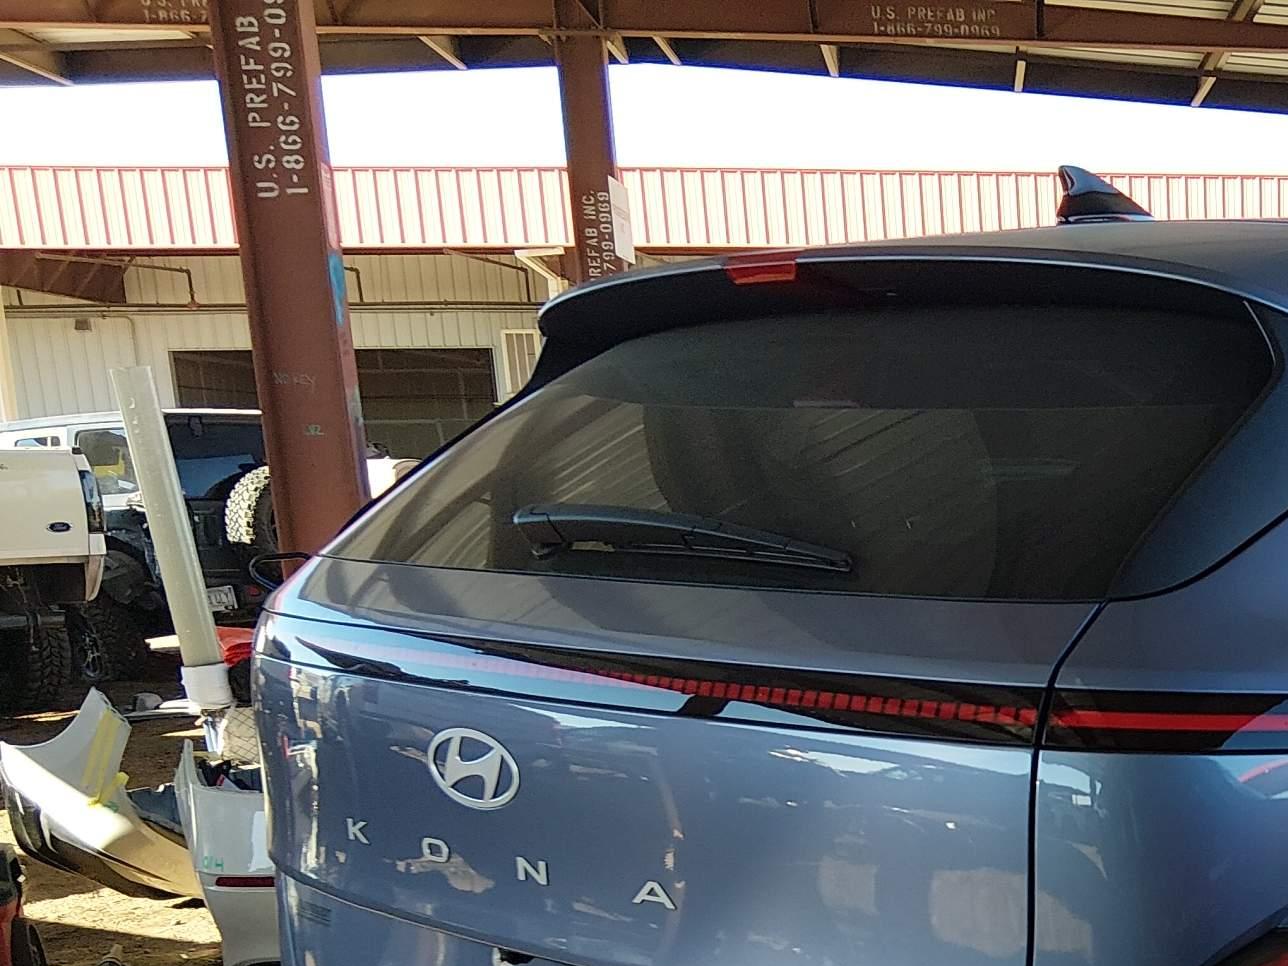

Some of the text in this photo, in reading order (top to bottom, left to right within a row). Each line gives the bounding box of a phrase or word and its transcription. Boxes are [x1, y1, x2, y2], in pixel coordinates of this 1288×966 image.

[872, 21, 1001, 37] 1-866-799-0969
[907, 6, 965, 22] PREFAB
[235, 15, 280, 199] U.S. PREFAB
[264, 0, 309, 195] 1-866-799-0
[582, 189, 597, 220] INC.
[346, 817, 677, 911] KONA
